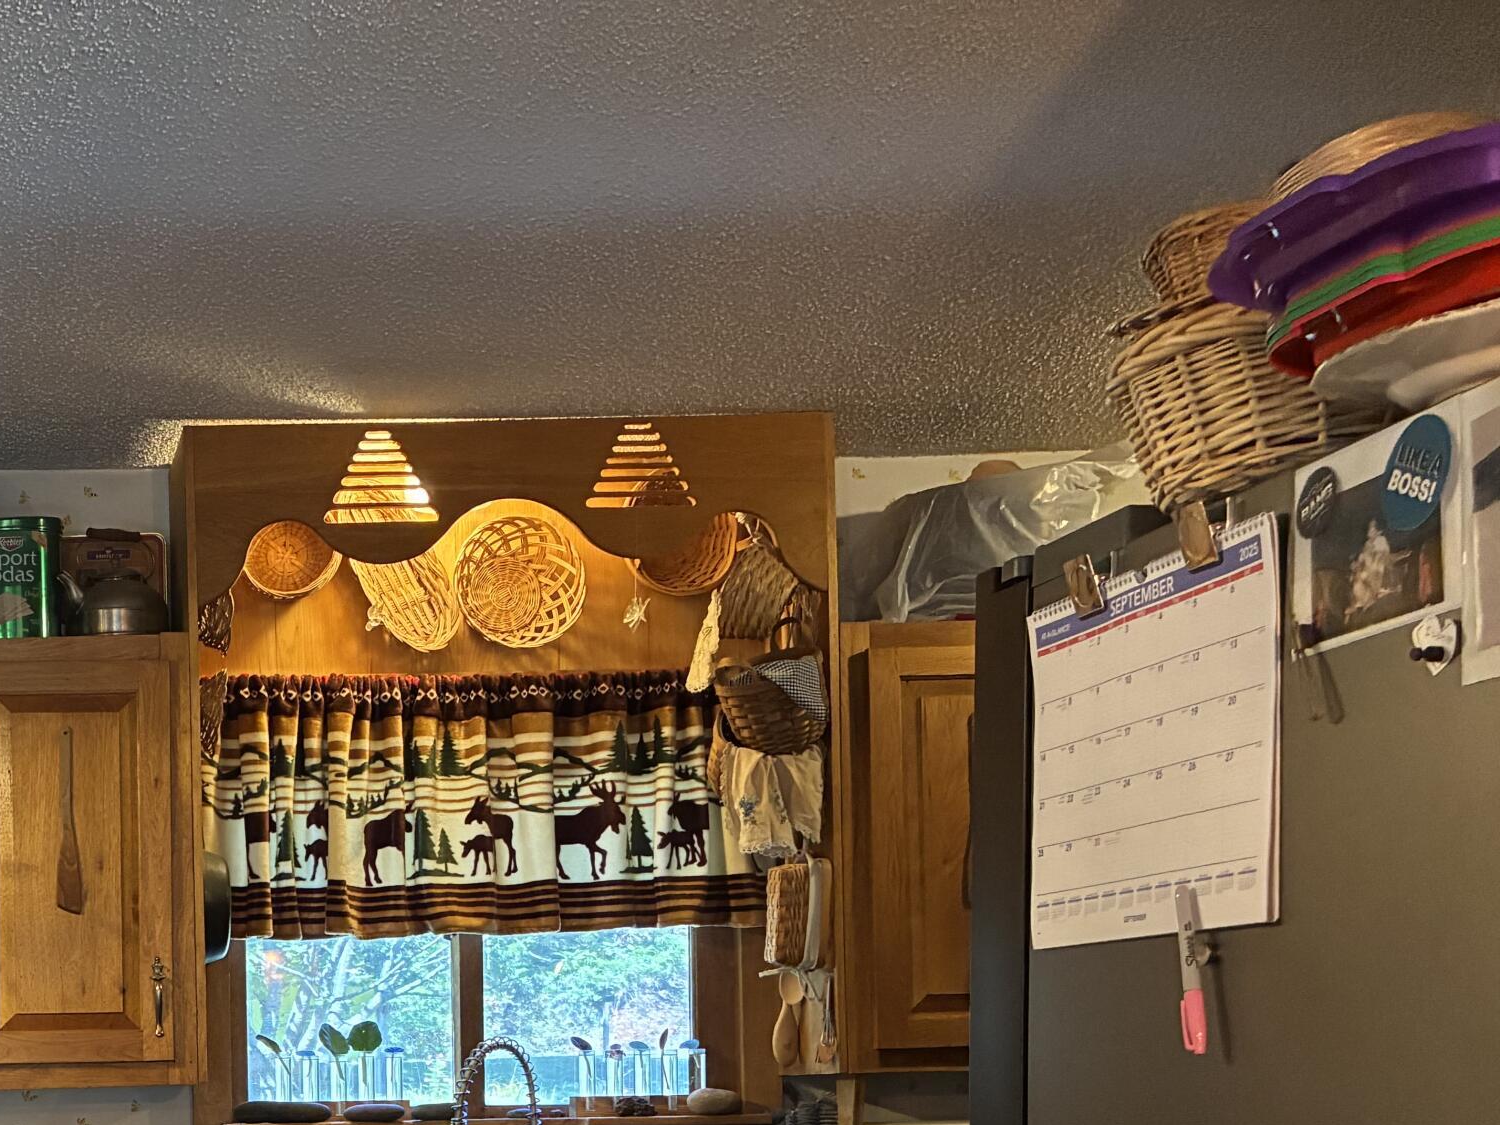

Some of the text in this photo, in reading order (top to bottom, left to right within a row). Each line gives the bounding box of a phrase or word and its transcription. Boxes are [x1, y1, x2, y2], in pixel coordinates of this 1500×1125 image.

[1387, 469, 1437, 504] BOSS!
[1239, 542, 1259, 562] 2025
[1110, 575, 1174, 617] SEPTEMBER
